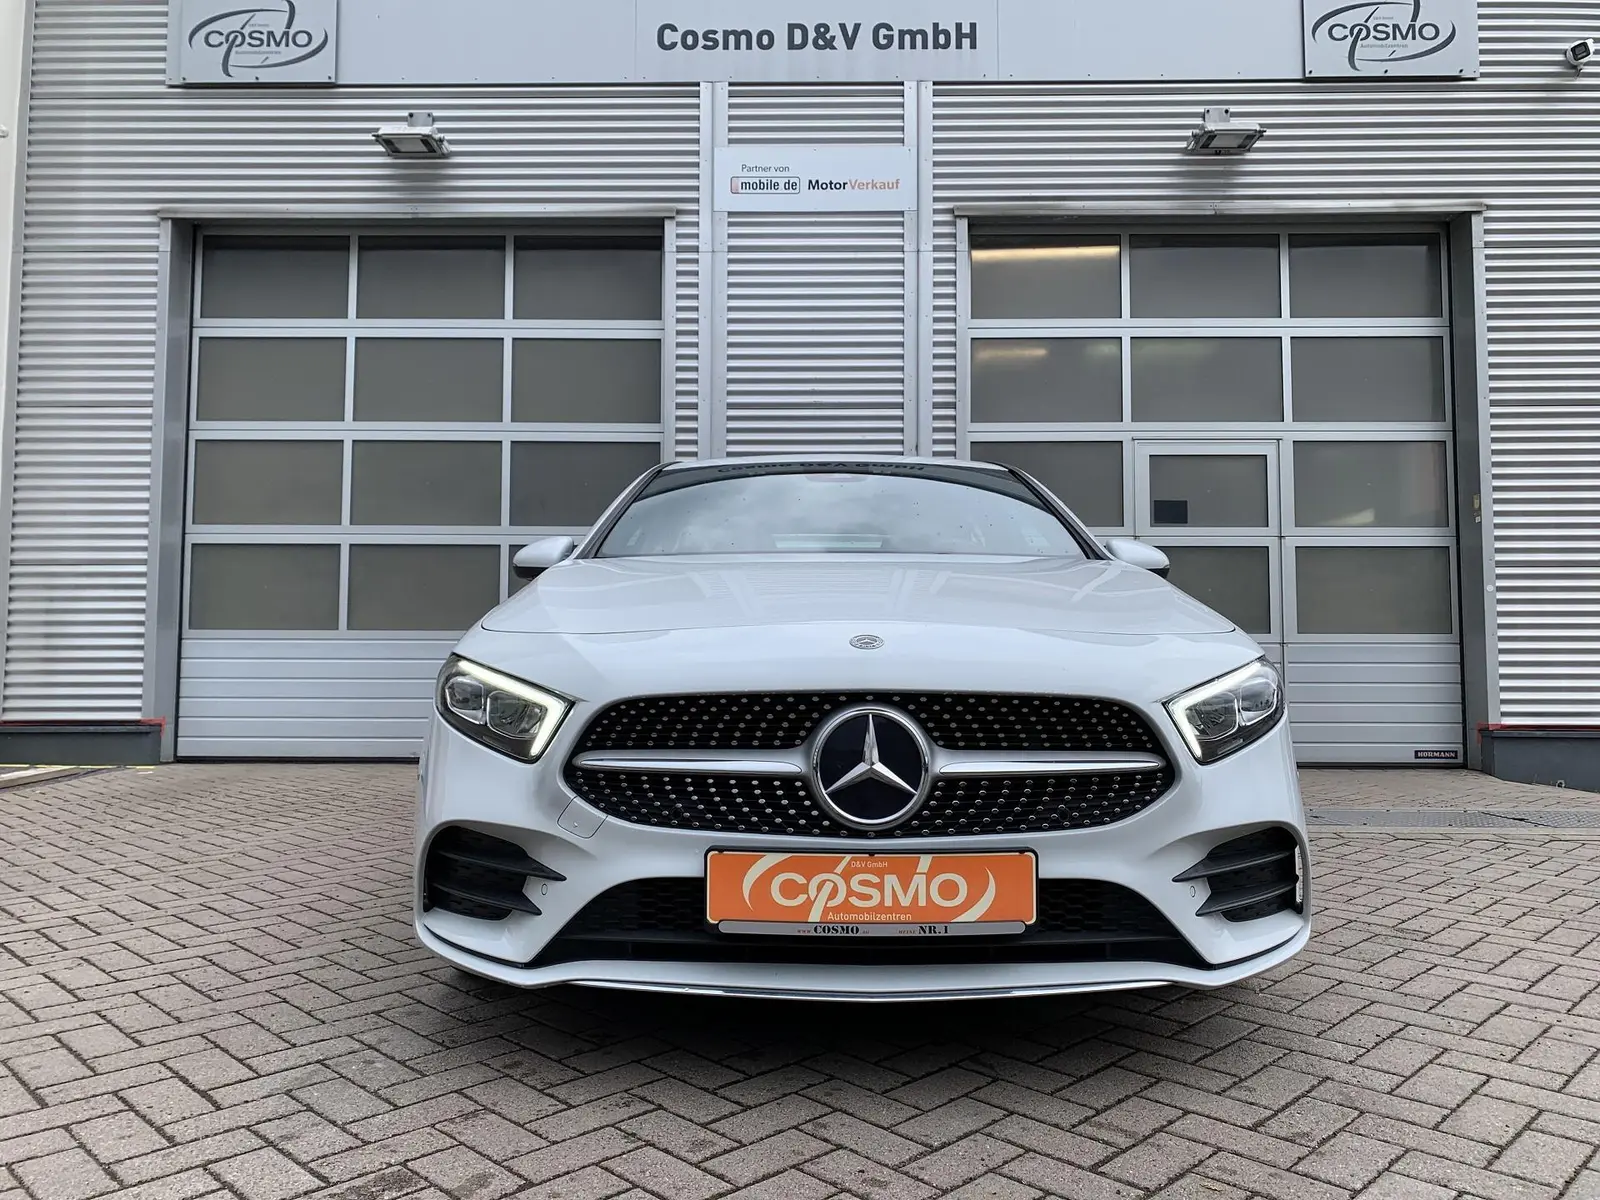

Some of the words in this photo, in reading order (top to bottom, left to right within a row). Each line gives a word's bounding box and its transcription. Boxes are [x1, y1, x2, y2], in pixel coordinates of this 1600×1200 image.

[656, 22, 776, 51] Cosmo
[787, 22, 862, 51] D&V
[871, 22, 978, 51] GmbH
[1327, 22, 1440, 42] COSMO
[203, 30, 313, 48] COSMO
[741, 164, 772, 173] Partner
[773, 165, 790, 173] von
[807, 179, 901, 191] MotorVerkauf
[851, 860, 866, 868] D&V
[867, 860, 888, 868] GmbH
[770, 872, 968, 908] COSMO
[827, 911, 912, 921] Automobilzentren
[813, 924, 860, 935] COSMO
